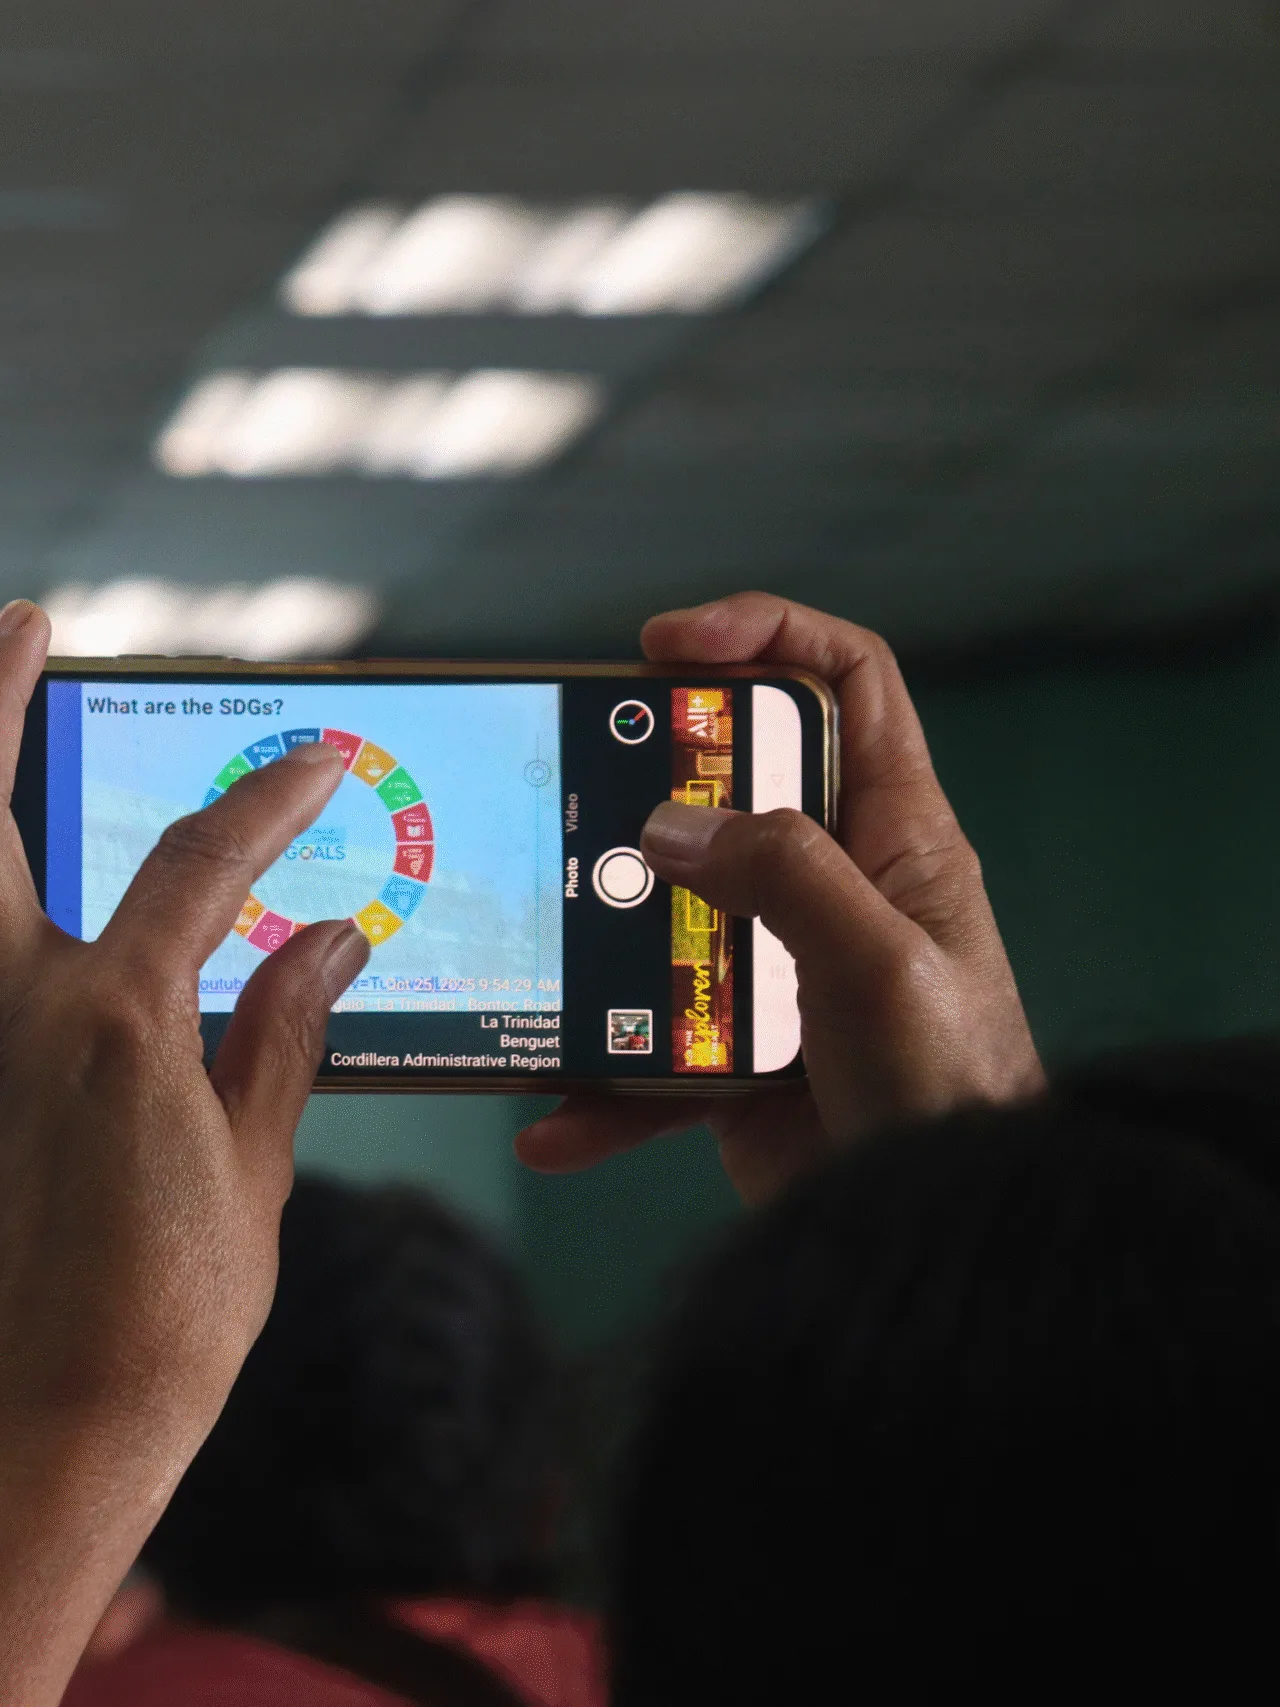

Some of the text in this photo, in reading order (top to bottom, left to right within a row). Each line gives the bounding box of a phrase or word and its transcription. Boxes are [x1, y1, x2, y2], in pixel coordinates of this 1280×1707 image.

[86, 696, 284, 715] What are the SDGs?
[565, 793, 578, 833] Video
[284, 845, 346, 860] GOALS
[565, 857, 579, 898] Photo
[385, 977, 410, 991] Oct
[440, 977, 475, 992] 2025
[479, 977, 532, 992] 9:54:29
[537, 978, 560, 992] AM
[400, 997, 456, 1011] Trinidad
[468, 998, 518, 1011] Bontoc
[523, 998, 560, 1011] Road
[480, 1014, 560, 1029] La Trinidad
[500, 1034, 560, 1050] Benguet
[331, 1052, 560, 1070] Cordillera Administrative Region
